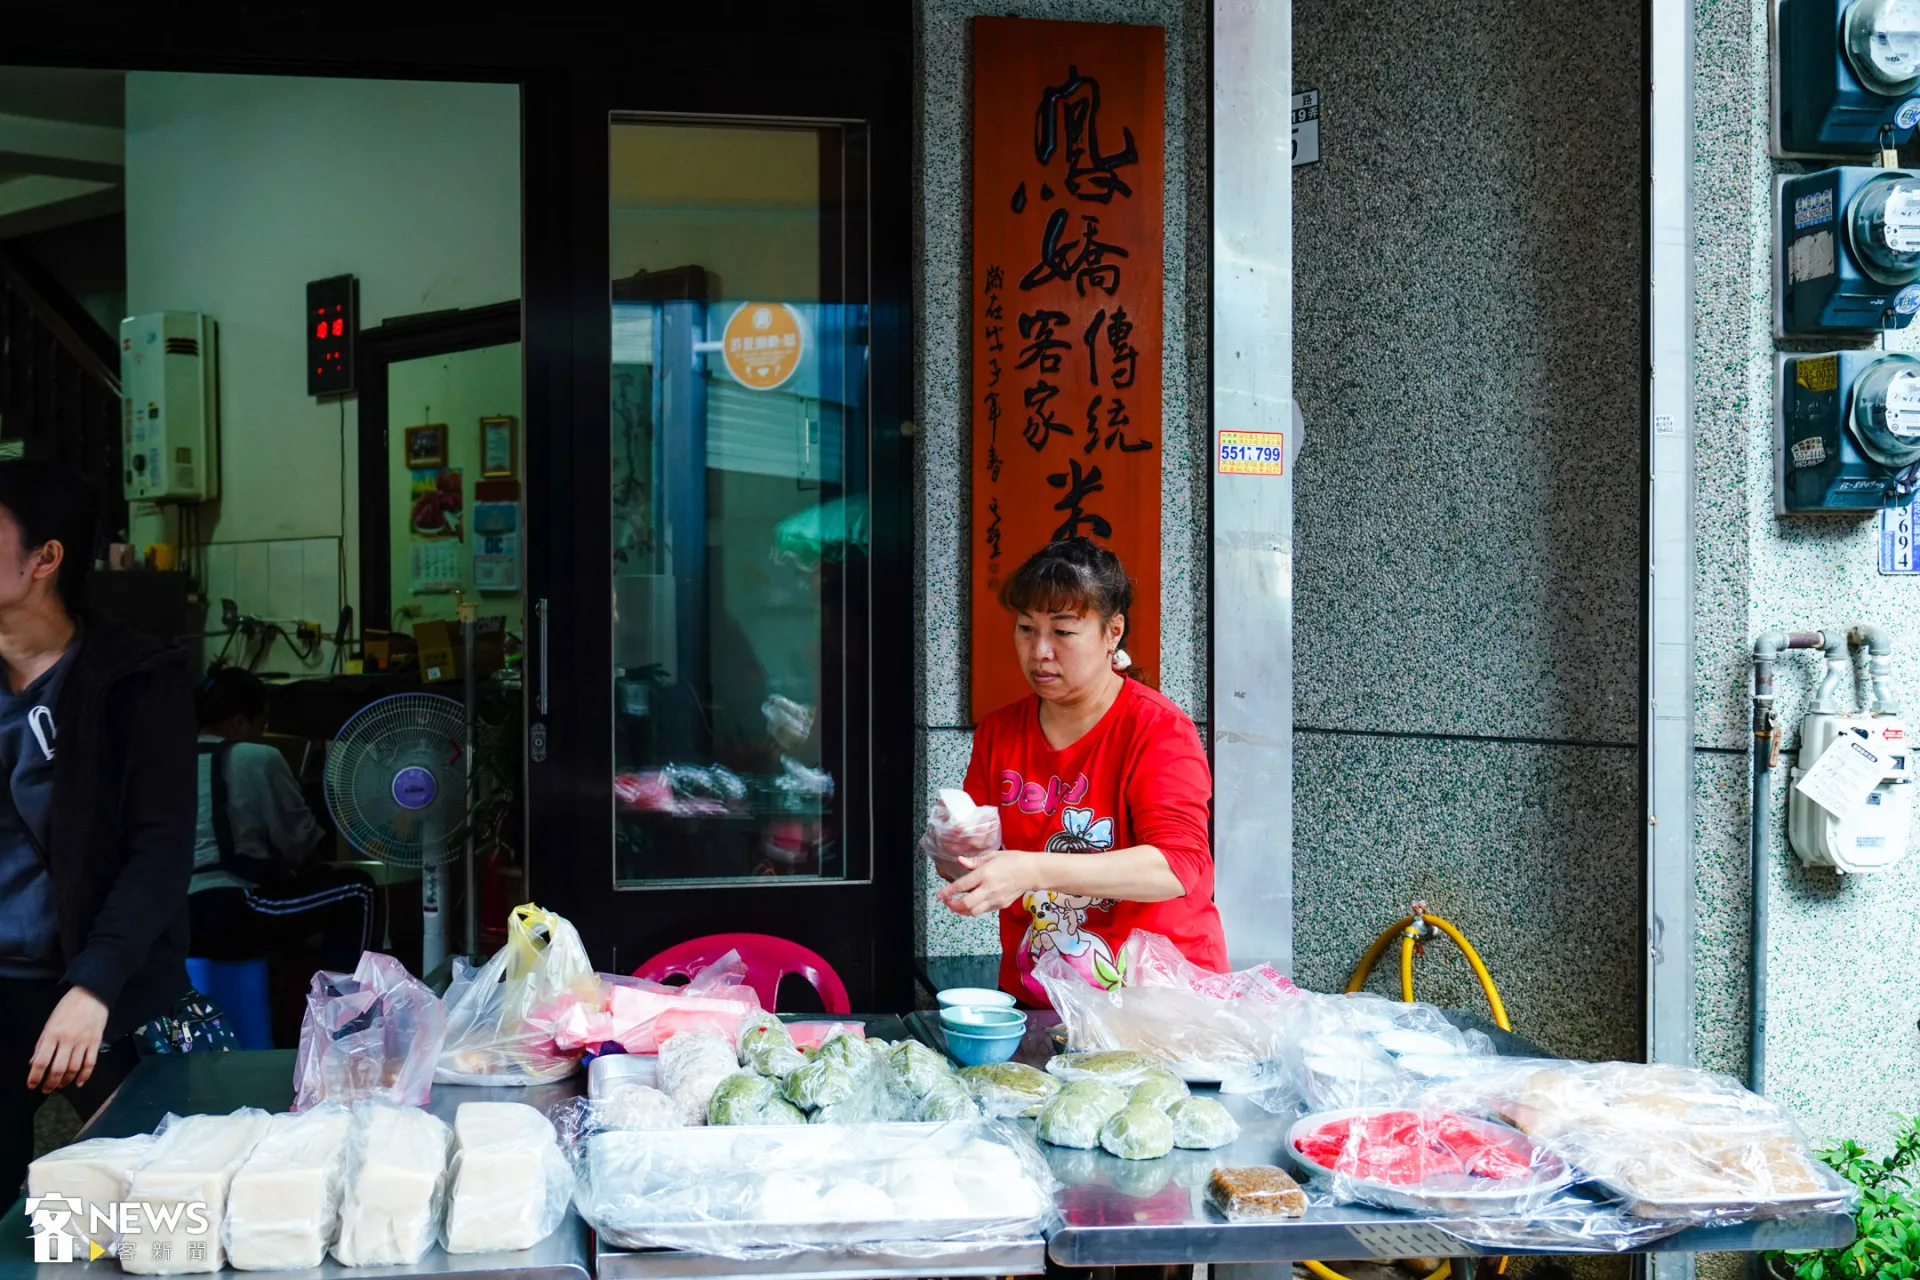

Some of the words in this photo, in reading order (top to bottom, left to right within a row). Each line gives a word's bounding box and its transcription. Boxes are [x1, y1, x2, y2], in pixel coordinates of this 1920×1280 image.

[1013, 309, 1074, 453] 客家
[1083, 307, 1153, 454] 傳統
[1047, 459, 1112, 541] 米
